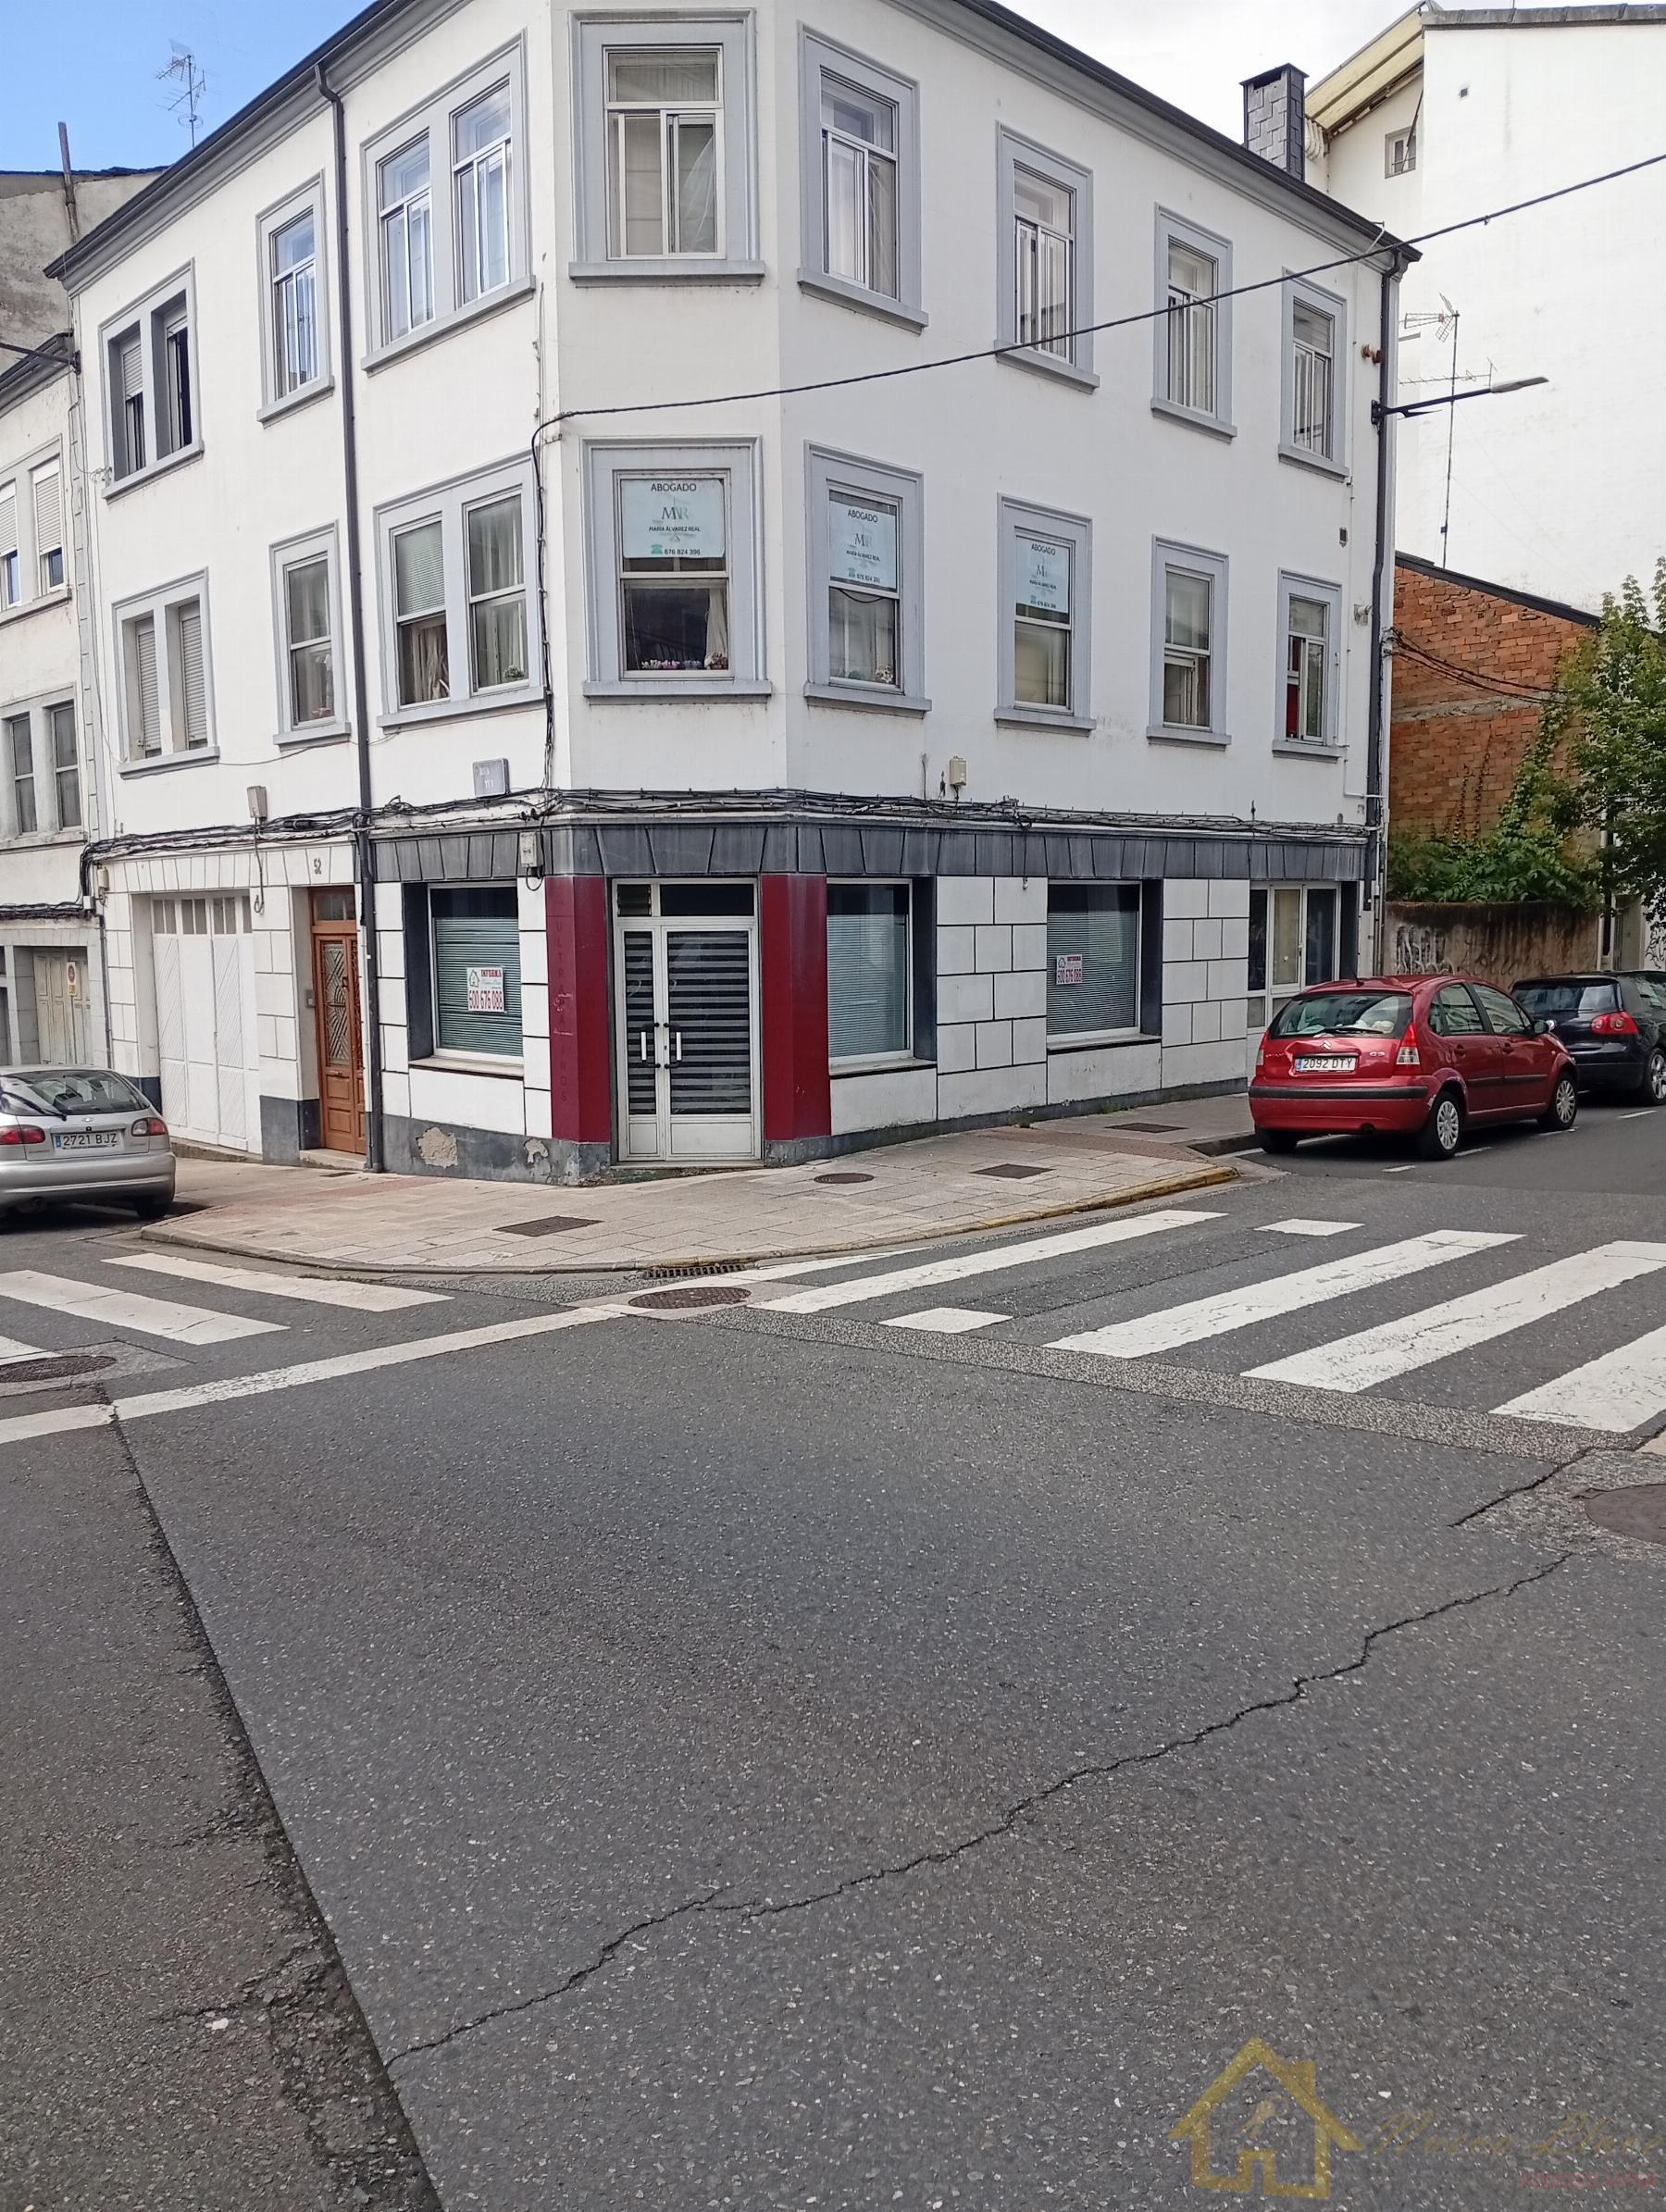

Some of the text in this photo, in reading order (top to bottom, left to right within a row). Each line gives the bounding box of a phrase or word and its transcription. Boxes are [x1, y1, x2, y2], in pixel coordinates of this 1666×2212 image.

[651, 483, 697, 492] ABOGADO
[848, 509, 878, 523] ABOGADO
[1031, 542, 1056, 555] ABOGADO
[313, 857, 322, 875] 52
[1302, 1058, 1353, 1069] 2092 DTY
[63, 1133, 118, 1146] 2721 BJZ
